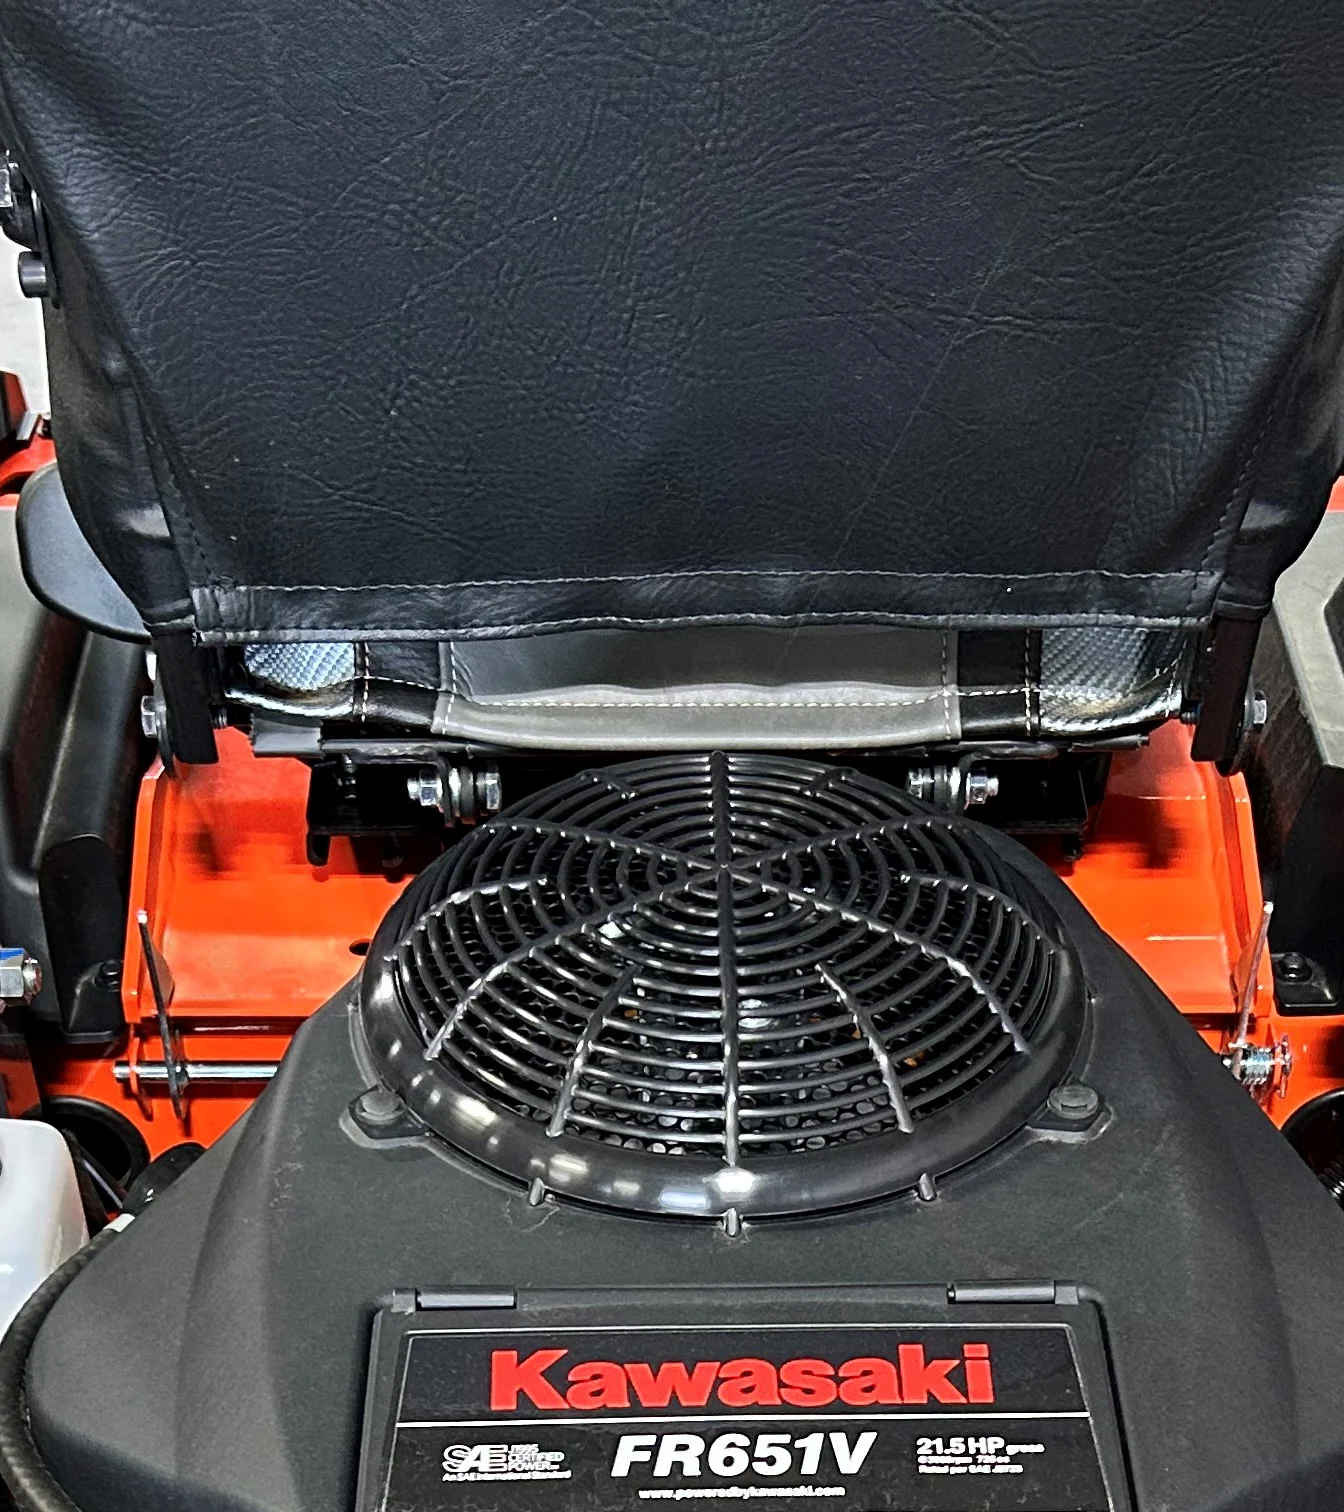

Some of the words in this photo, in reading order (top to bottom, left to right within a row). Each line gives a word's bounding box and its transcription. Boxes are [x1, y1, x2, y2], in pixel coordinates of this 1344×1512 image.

[490, 1343, 995, 1411] Kawasaki
[442, 1444, 508, 1472] SAE
[610, 1432, 878, 1477] FR651V
[916, 1437, 966, 1455] 21.5
[967, 1436, 1005, 1454] HP
[638, 1485, 846, 1501] www.poweredbykawasaki.com
